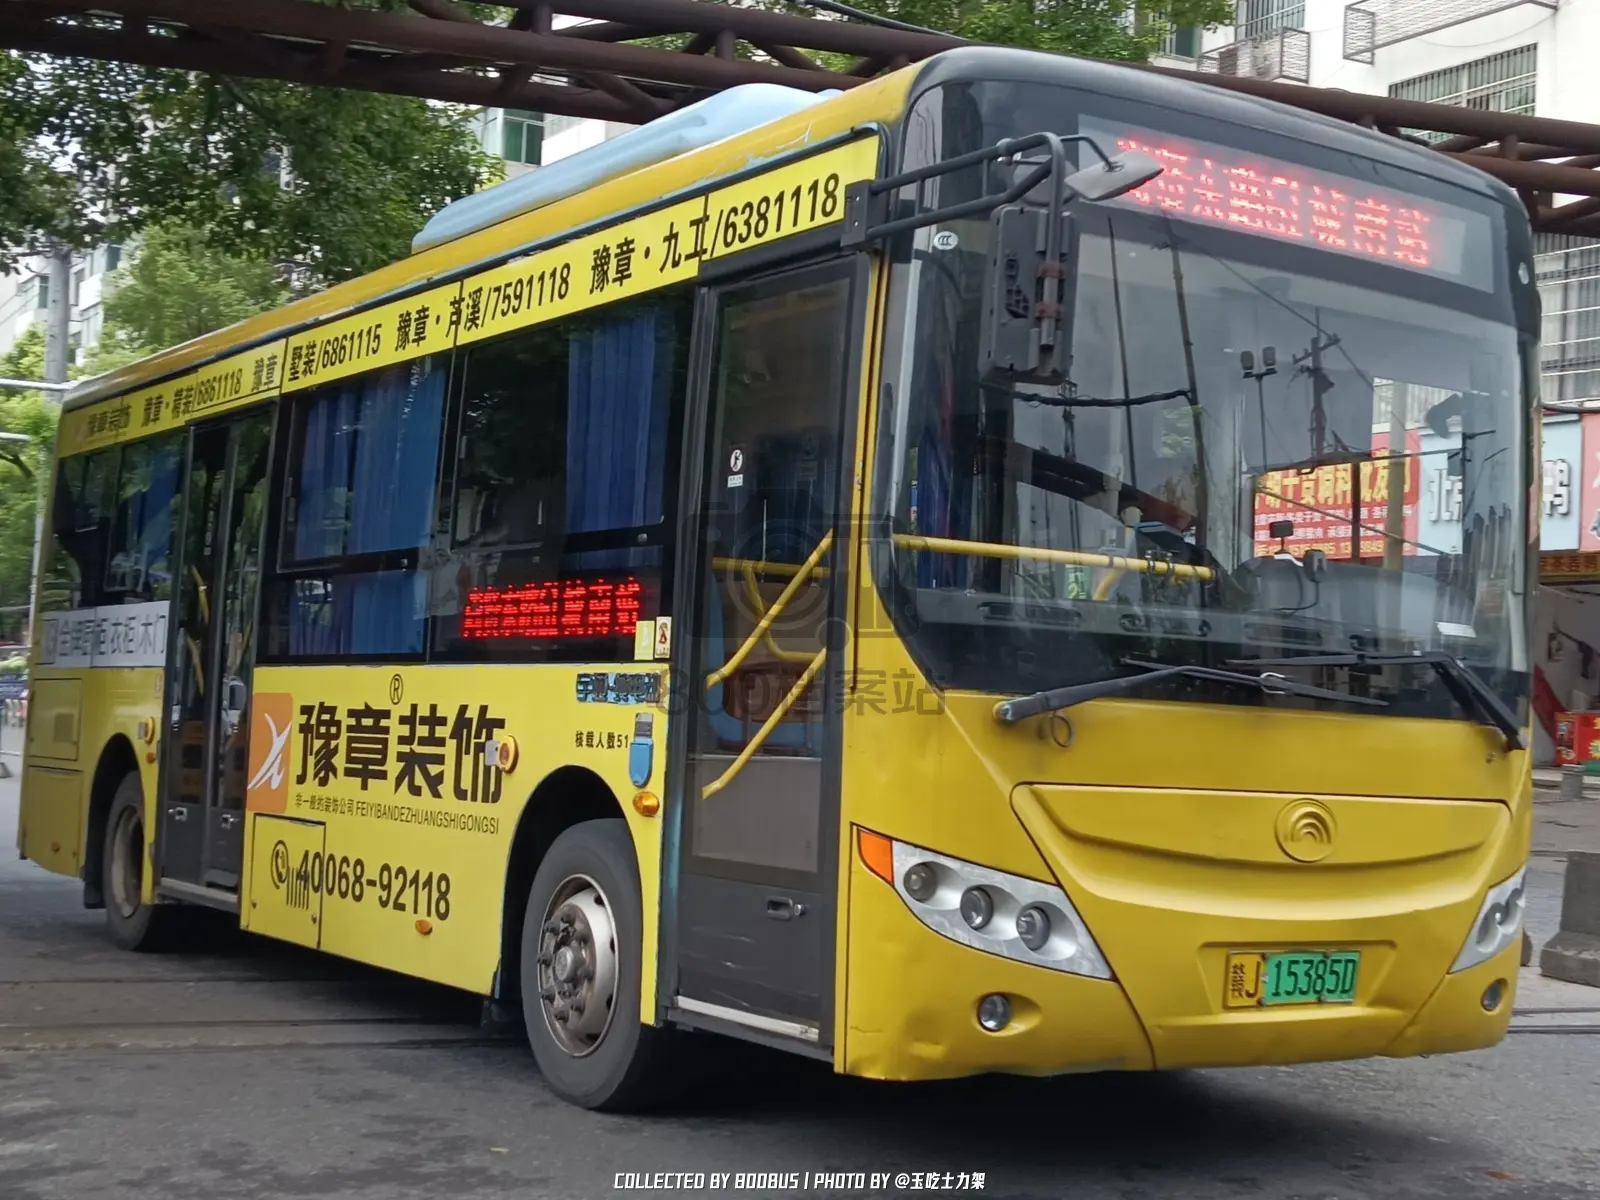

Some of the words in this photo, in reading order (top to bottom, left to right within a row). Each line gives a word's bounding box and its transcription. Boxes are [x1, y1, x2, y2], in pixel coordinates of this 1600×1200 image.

[295, 701, 505, 804] 豫章装饰
[575, 730, 629, 750] 核载人数51
[355, 800, 499, 835] FEIYIBANDEZHUANGSHIGONGSI
[300, 849, 451, 921] 40068-92118
